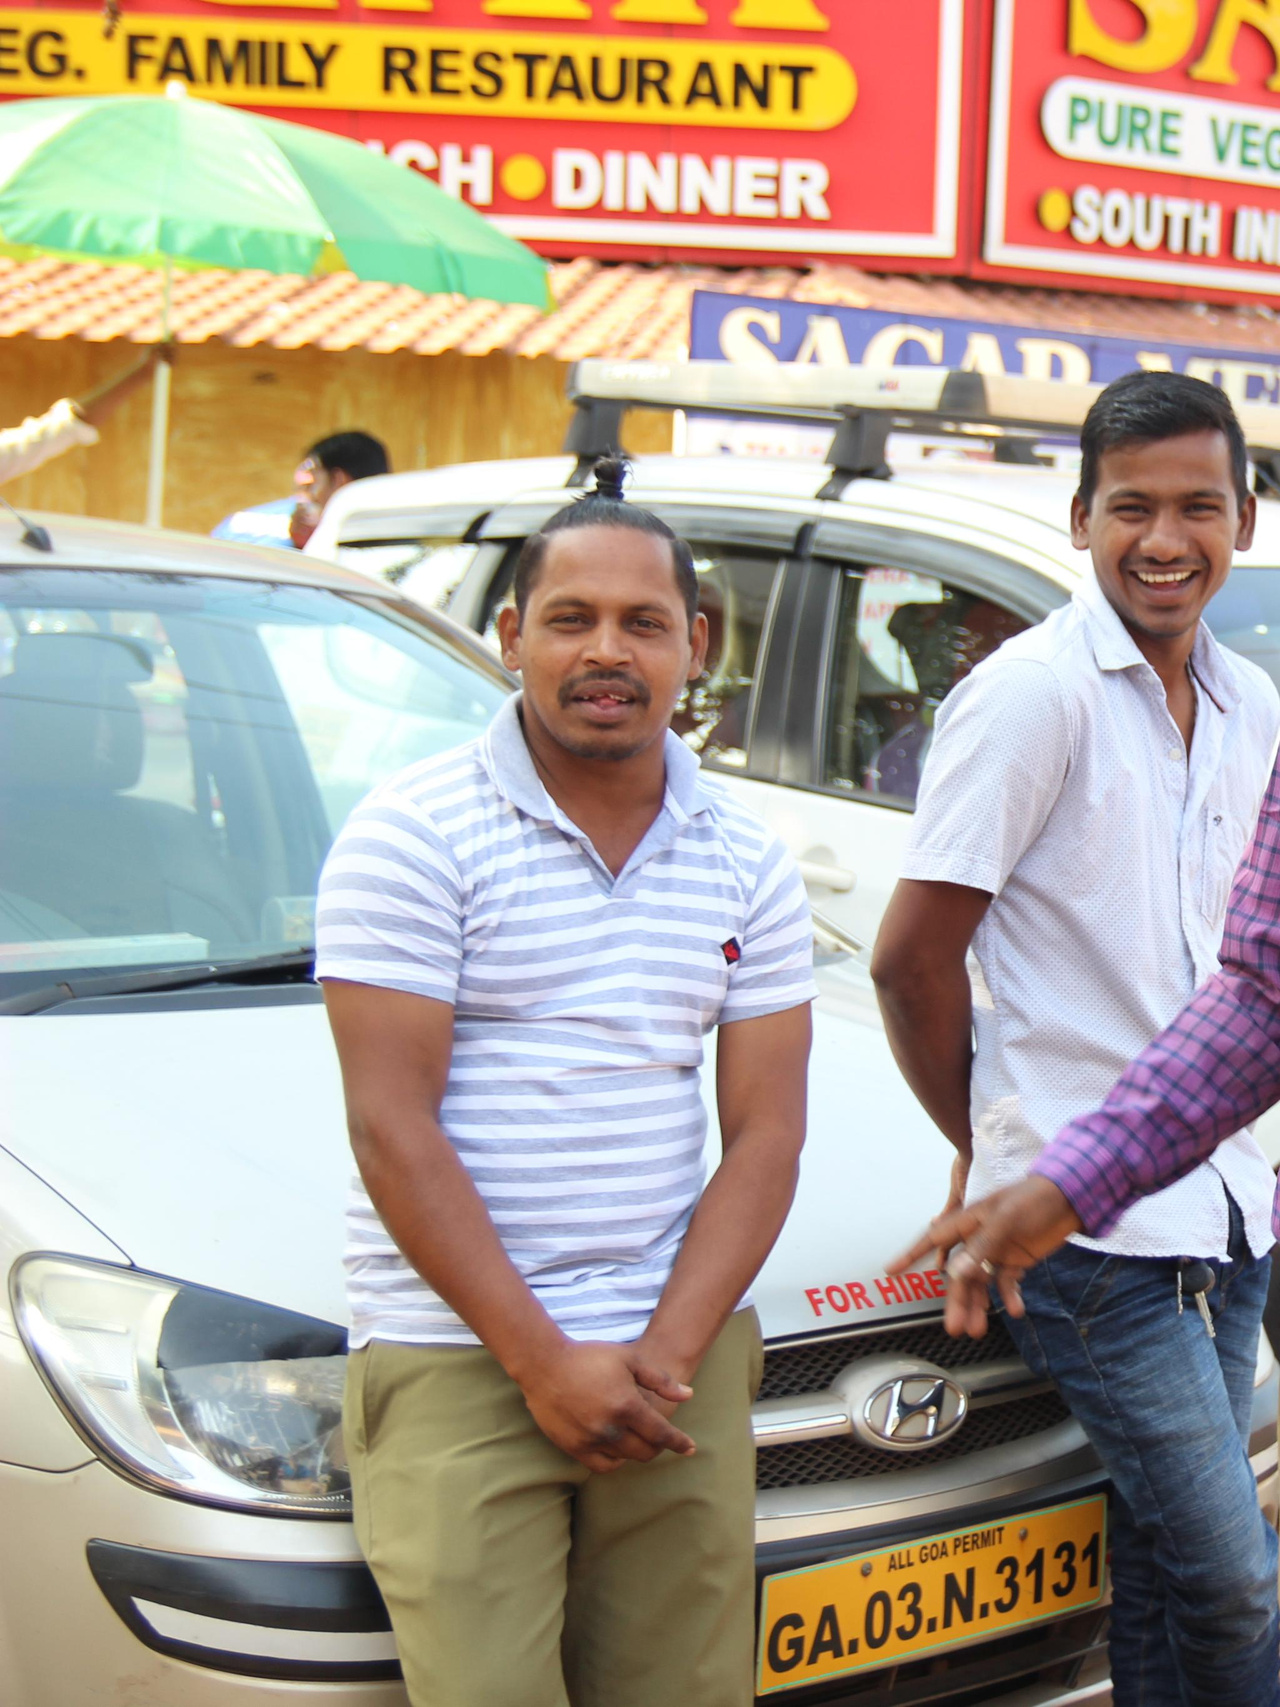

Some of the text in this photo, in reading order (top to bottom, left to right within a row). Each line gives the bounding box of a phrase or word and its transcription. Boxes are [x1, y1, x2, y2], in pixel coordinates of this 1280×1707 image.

[126, 34, 340, 90] FAMILY
[383, 46, 815, 112] RESTAURANT
[1069, 96, 1182, 158] PURE
[551, 147, 832, 221] DINNER
[1070, 184, 1221, 258] SOUTH
[804, 1269, 948, 1318] FOR HIRE
[887, 1525, 1006, 1573] ALL GOA PERMIT
[765, 1531, 1101, 1675] GA.03.N.3131
